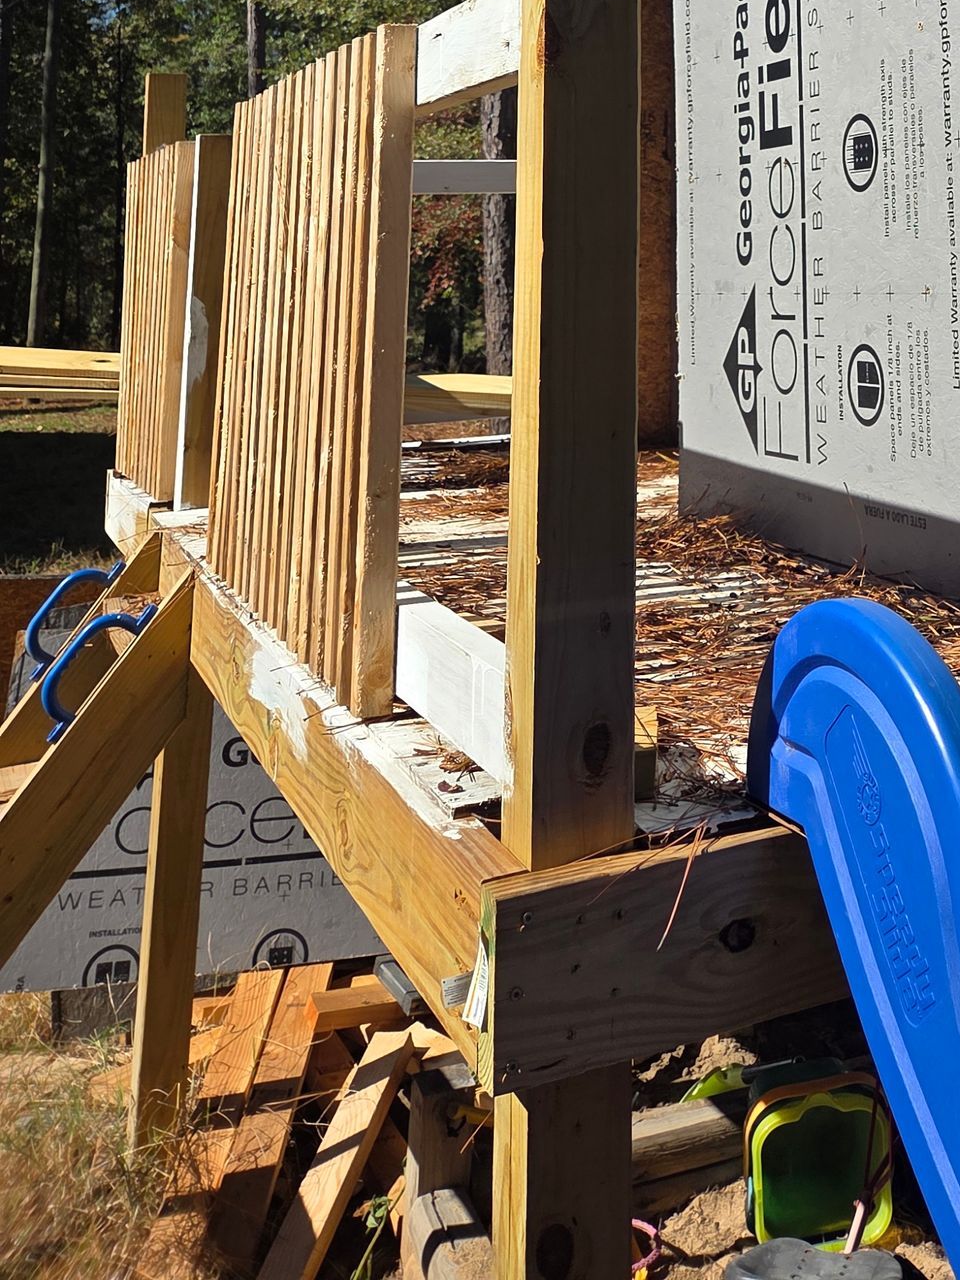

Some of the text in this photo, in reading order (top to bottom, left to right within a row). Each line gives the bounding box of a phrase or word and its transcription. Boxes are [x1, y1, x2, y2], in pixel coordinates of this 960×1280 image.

[809, 52, 823, 229] BARRIER
[945, 152, 953, 172] at:
[945, 176, 956, 247] available
[949, 251, 959, 324] Warranty
[737, 326, 756, 414] GP
[811, 257, 828, 465] WEATHER
[836, 344, 844, 421] INSTALLATION
[951, 329, 960, 389] Limited
[870, 822, 936, 1011] Speedy
[871, 886, 918, 1012] Slide
